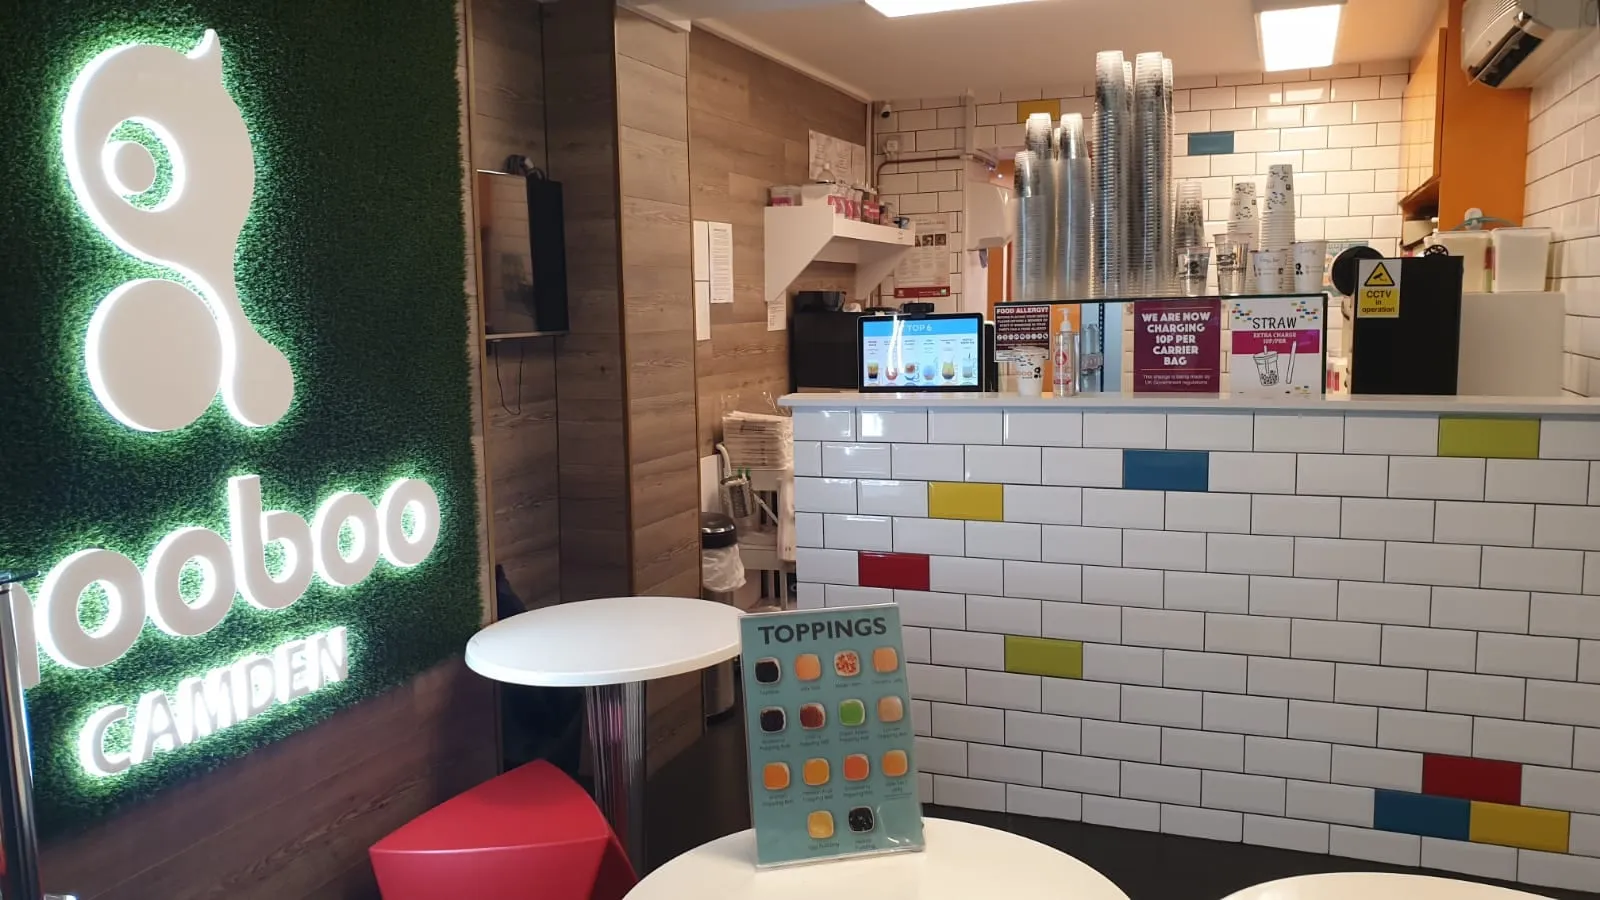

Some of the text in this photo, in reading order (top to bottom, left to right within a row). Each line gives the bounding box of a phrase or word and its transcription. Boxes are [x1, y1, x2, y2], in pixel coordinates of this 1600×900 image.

[1366, 290, 1392, 298] CCTV
[1362, 306, 1395, 314] operation
[1141, 311, 1211, 322] WE ARE NOW
[907, 323, 933, 332] TOP 6
[1252, 316, 1297, 329] STRAW
[1146, 323, 1206, 333] CHARGING
[1155, 334, 1196, 344] 10P PER
[1152, 345, 1199, 355] CARRIER
[1163, 356, 1187, 366] BAG
[757, 617, 887, 645] TOPPINGS
[79, 627, 347, 777] CAMDEN
